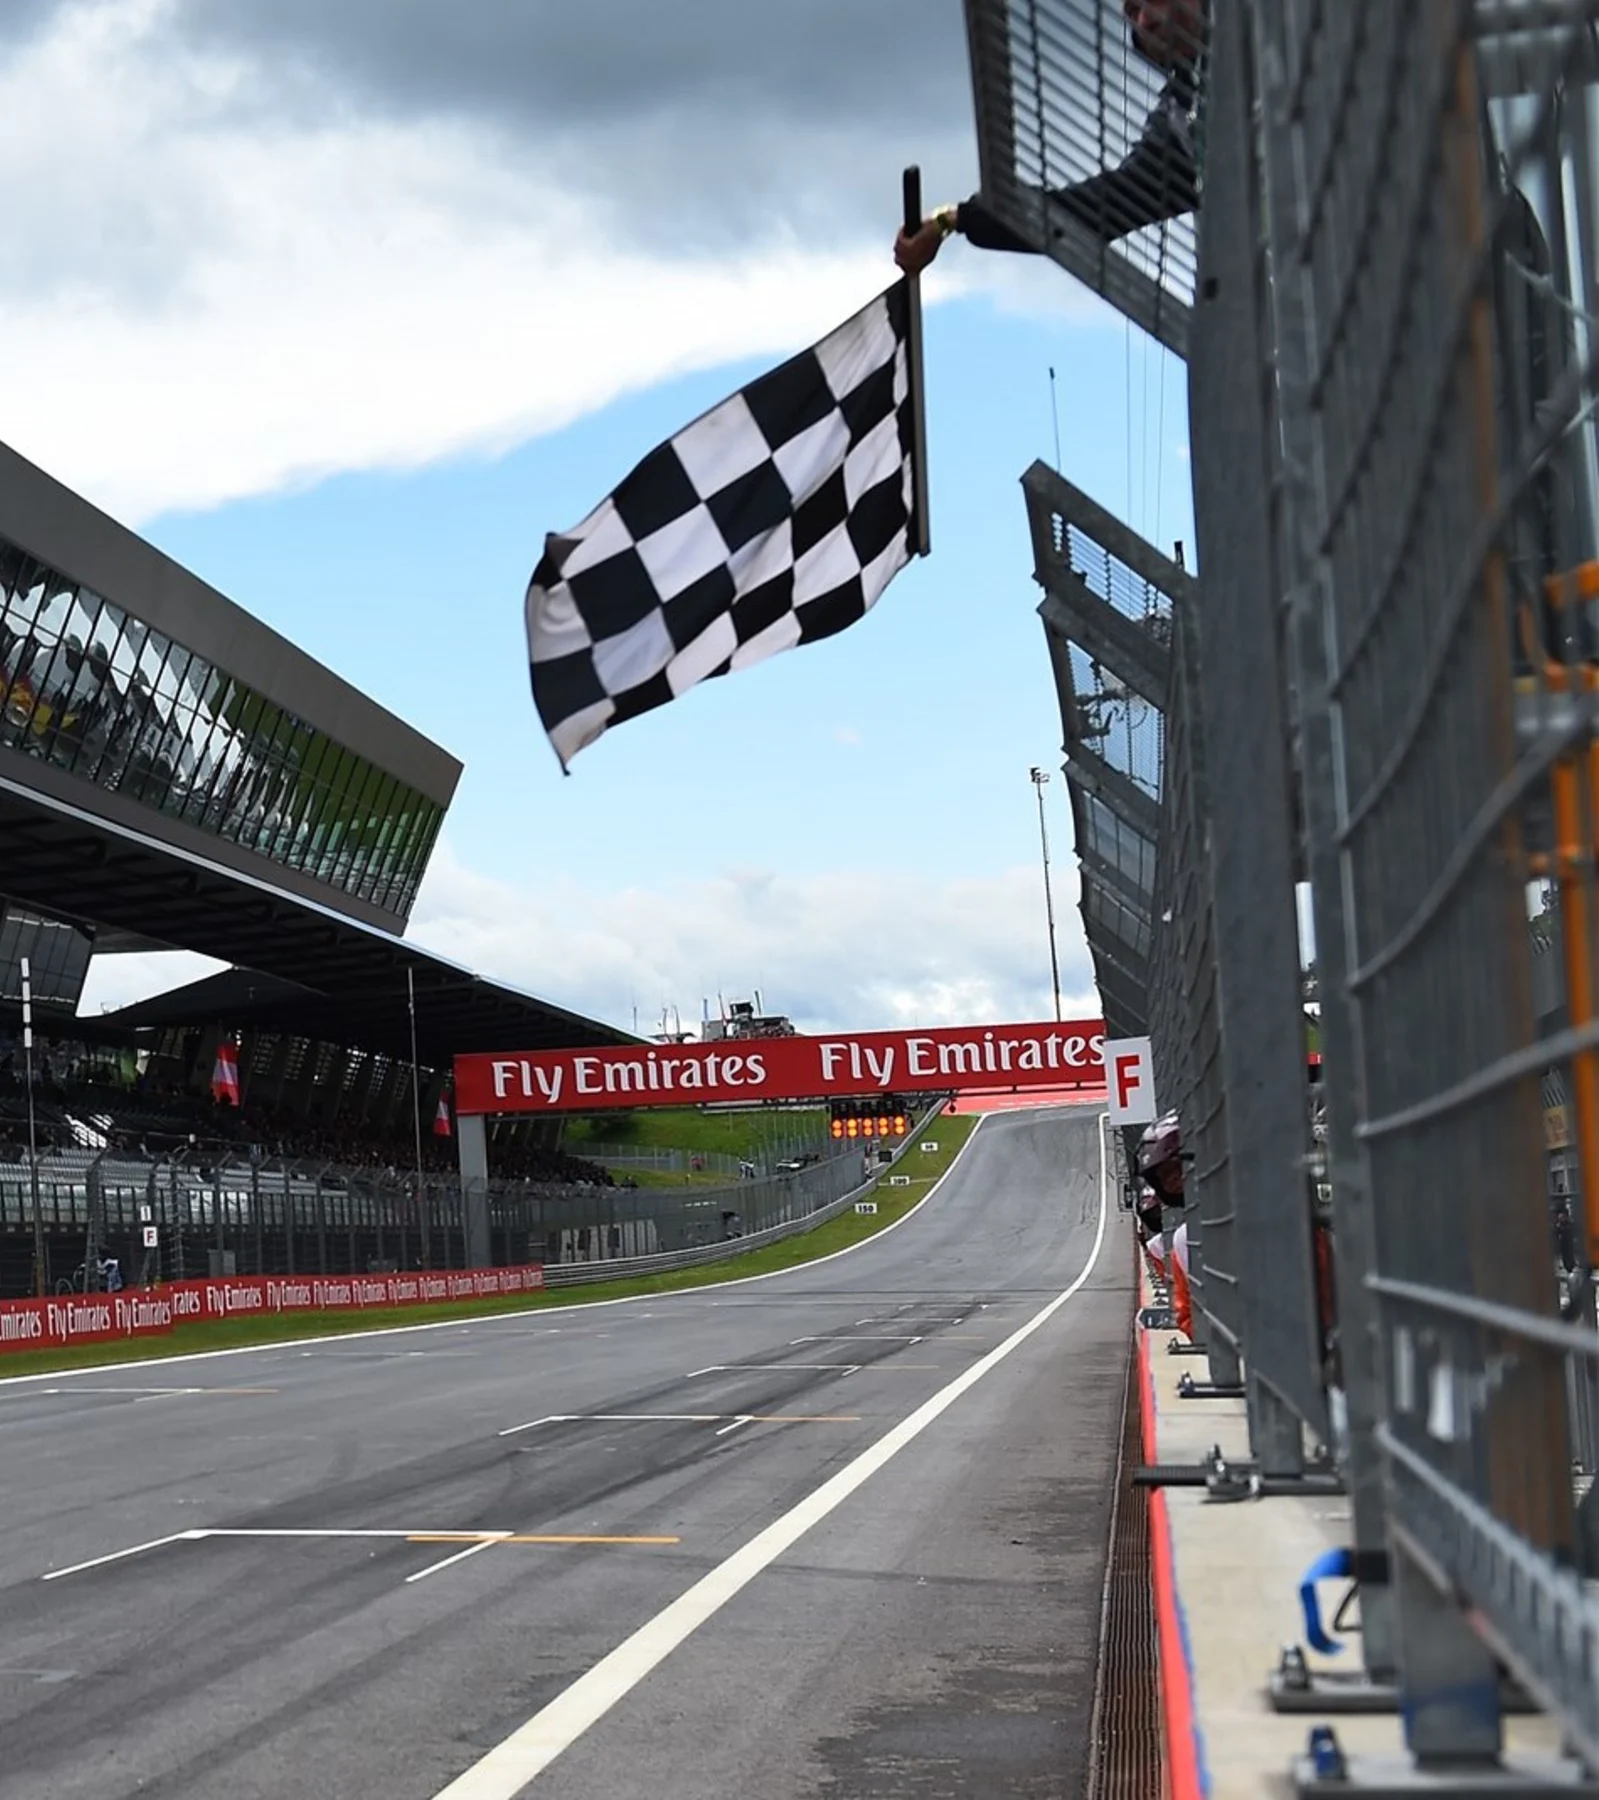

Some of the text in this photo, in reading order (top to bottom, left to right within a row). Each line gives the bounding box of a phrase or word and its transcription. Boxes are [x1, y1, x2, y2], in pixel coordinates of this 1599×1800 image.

[492, 1051, 767, 1104] Fly Emirates
[821, 1030, 1105, 1087] Fly Emirates
[1115, 1054, 1140, 1108] F
[858, 1204, 874, 1212] 150
[146, 1230, 154, 1243] F
[115, 1294, 171, 1338] Fly Emirates
[206, 1282, 262, 1317] Fly Emirates
[48, 1301, 111, 1342] Fly Emirates
